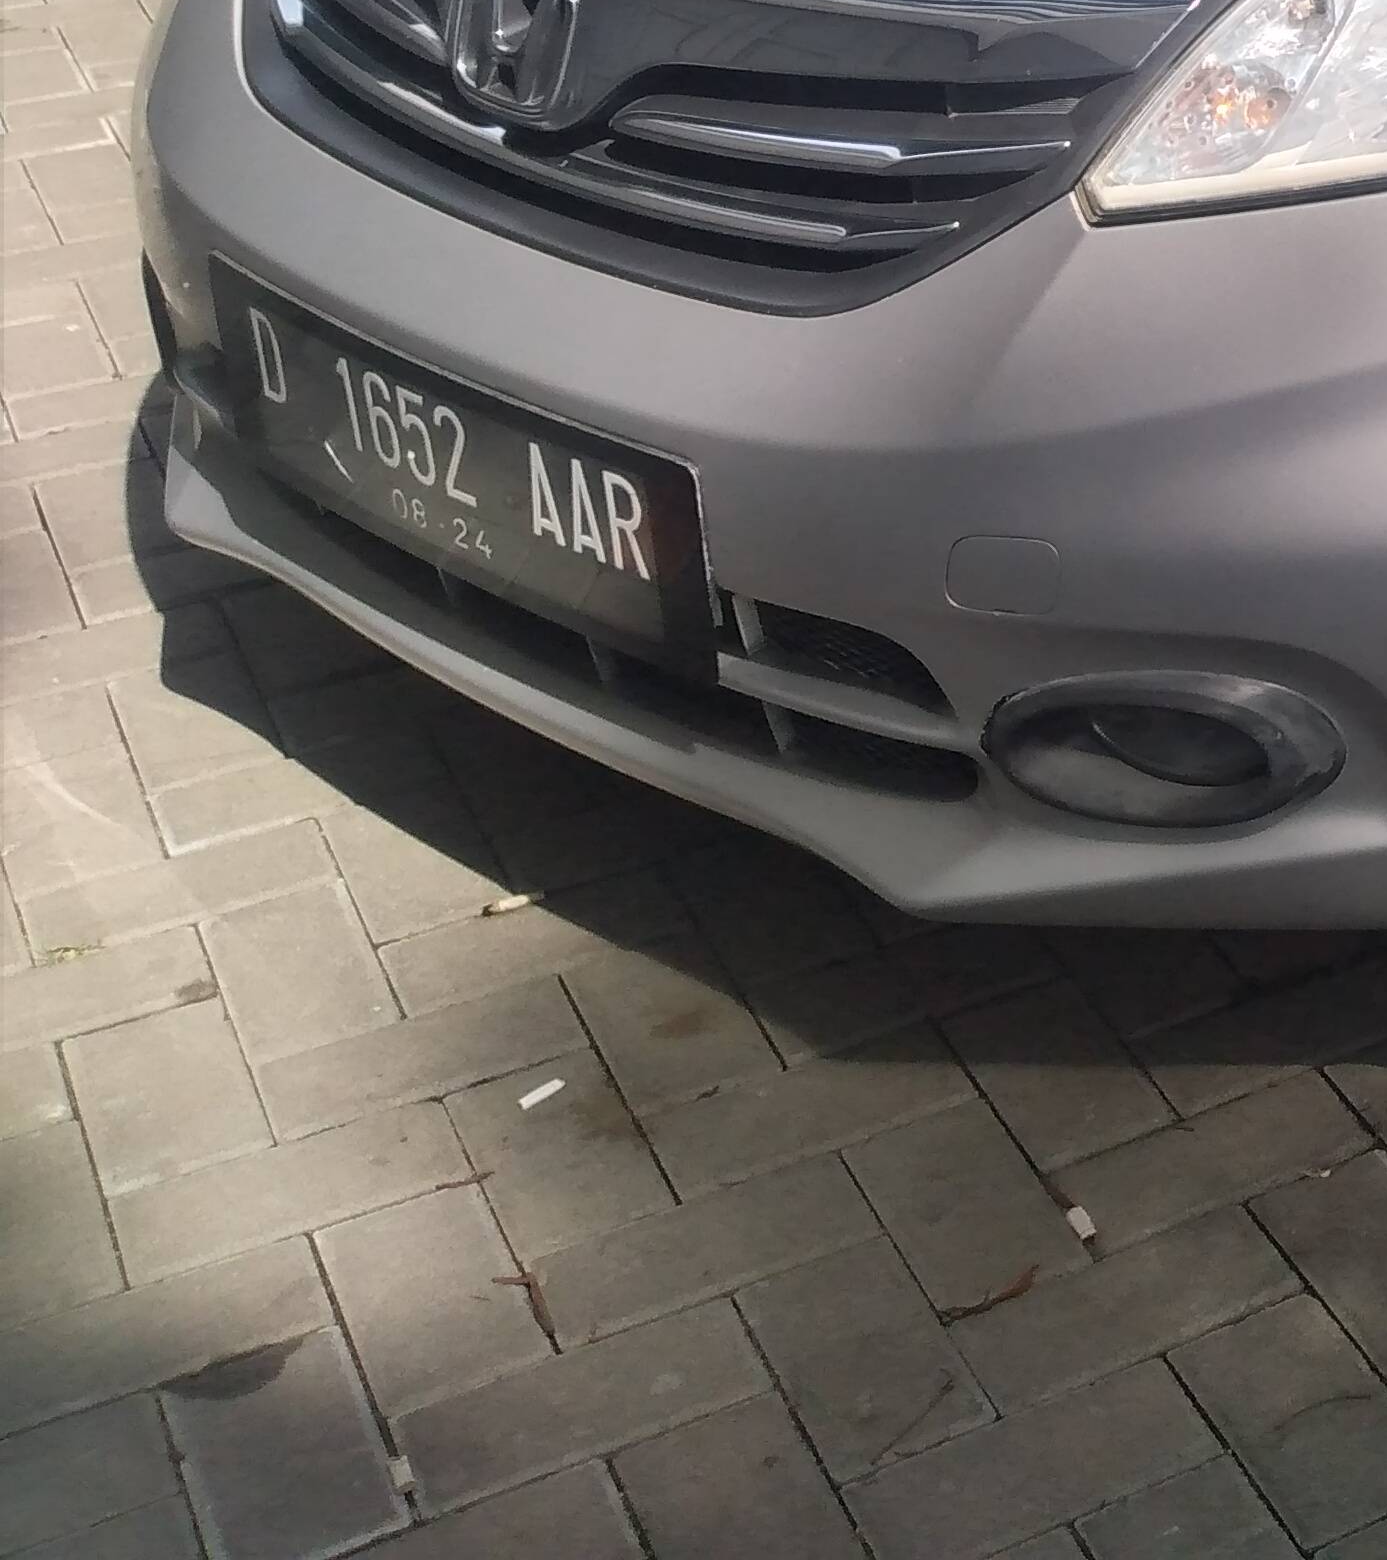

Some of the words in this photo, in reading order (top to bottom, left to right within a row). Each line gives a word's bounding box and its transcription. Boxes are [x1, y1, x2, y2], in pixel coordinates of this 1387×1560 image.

[250, 306, 287, 403] D
[335, 356, 478, 508] 1652
[527, 440, 651, 581] AAR
